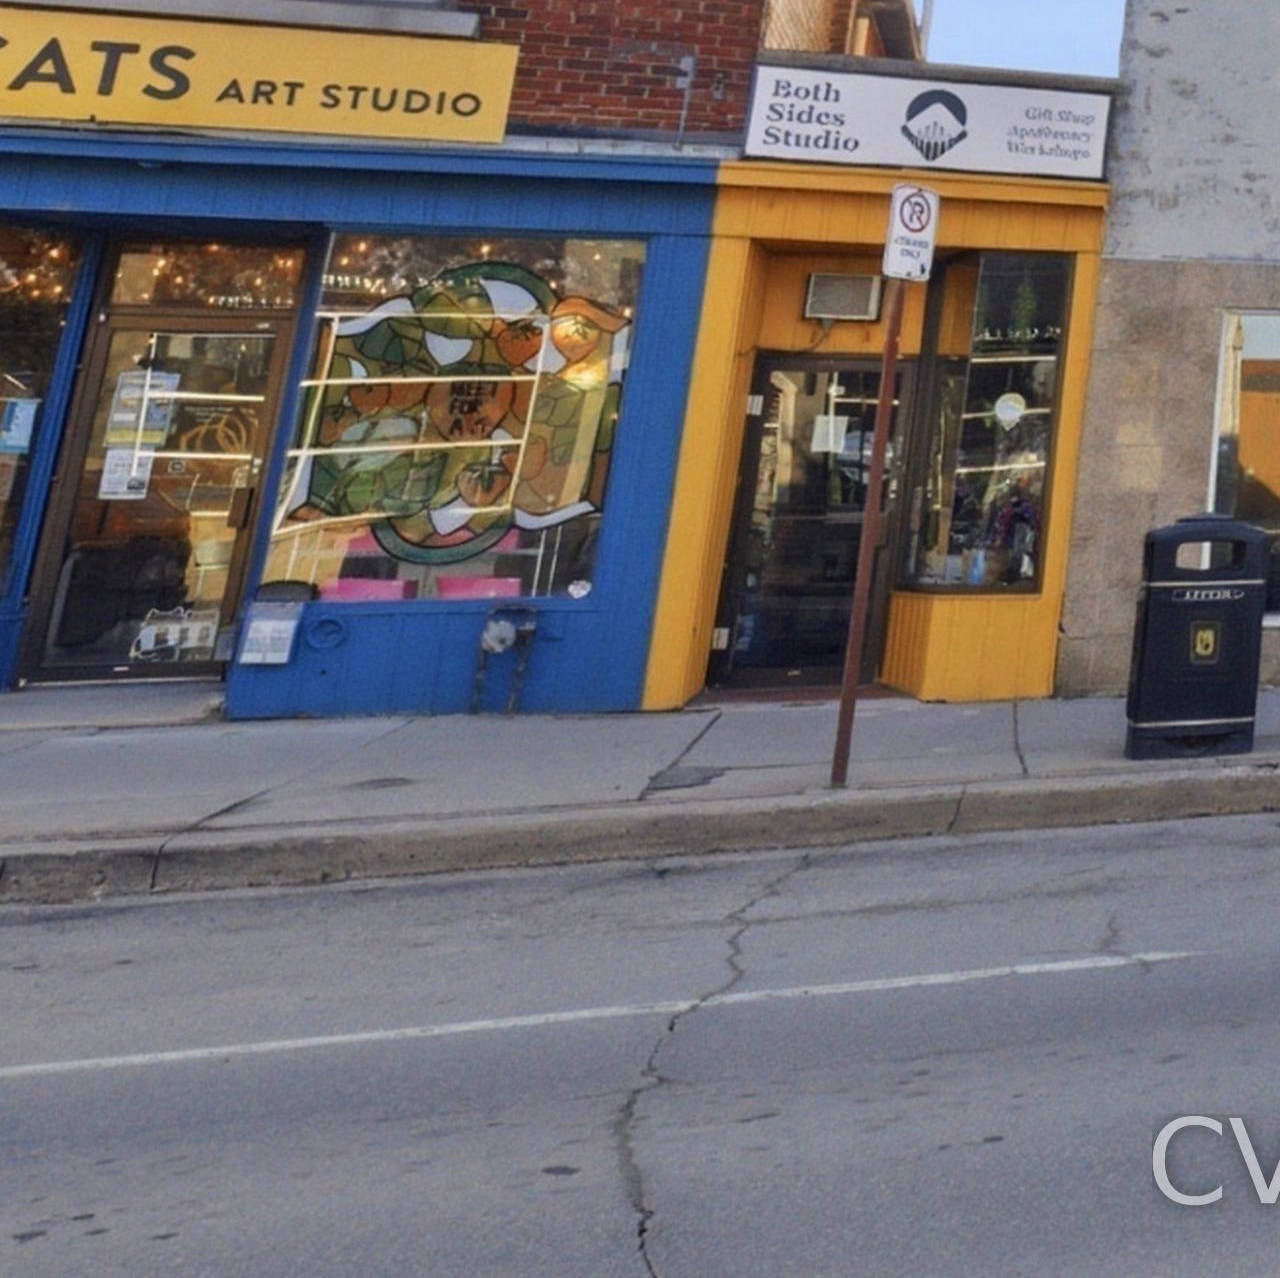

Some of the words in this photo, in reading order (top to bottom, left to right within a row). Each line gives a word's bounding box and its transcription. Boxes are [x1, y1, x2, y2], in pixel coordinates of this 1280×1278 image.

[0, 36, 196, 101] ATS
[215, 78, 305, 106] ART
[319, 83, 482, 117] STUDIO
[772, 79, 841, 103] Both
[766, 102, 845, 127] Sides
[762, 125, 860, 153] Studio
